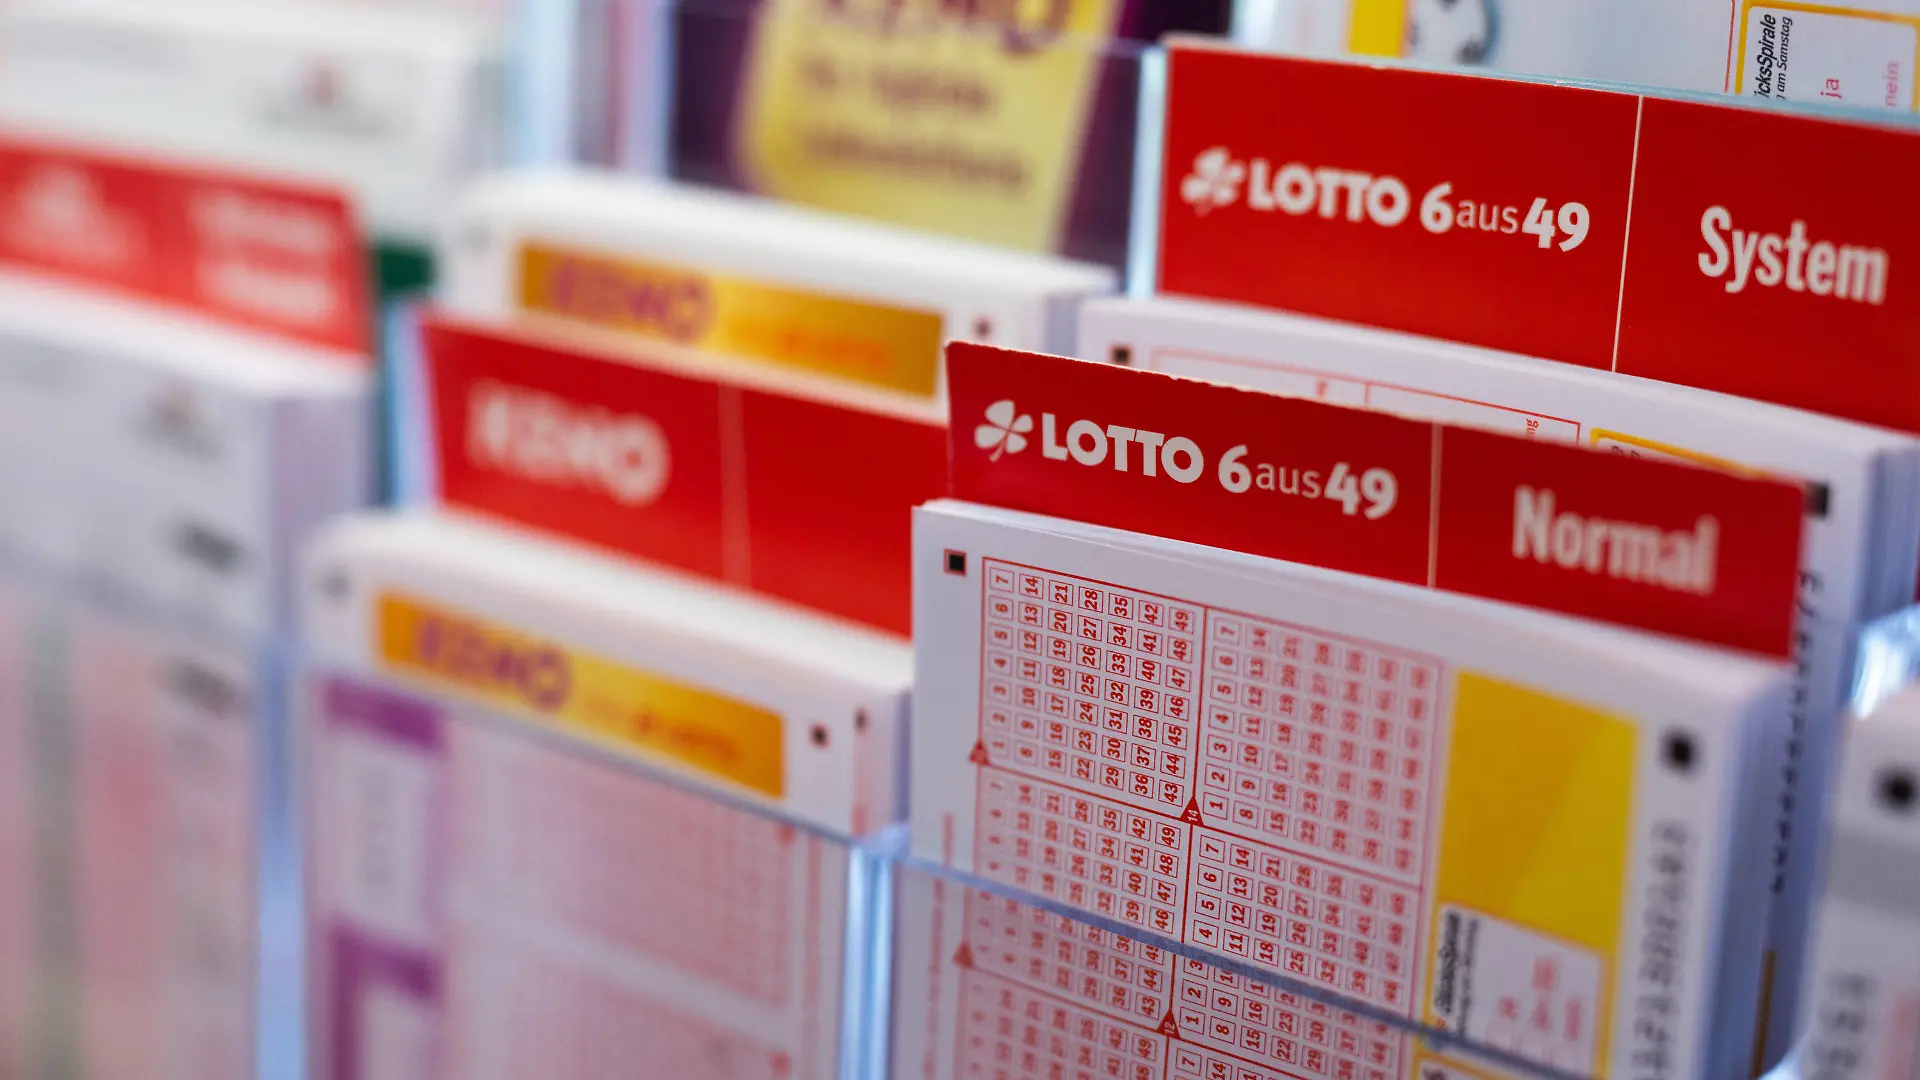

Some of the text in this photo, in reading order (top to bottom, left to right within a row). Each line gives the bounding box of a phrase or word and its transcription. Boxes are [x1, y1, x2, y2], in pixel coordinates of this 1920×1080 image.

[1776, 16, 1793, 93] am Samstag
[1820, 78, 1842, 99] ja
[1882, 60, 1899, 107] nein
[1248, 158, 1410, 226] LOTTO
[1698, 205, 1888, 305] System
[1042, 413, 1204, 483] LOTTO
[1514, 485, 1719, 595] Normal
[1025, 577, 1039, 596] 14
[1024, 605, 1038, 625] 13
[1023, 633, 1037, 653] 12
[1022, 661, 1036, 680] 11
[1047, 583, 1068, 769] 15 16 17 18 19 20 21
[1076, 590, 1097, 777] 22 23 24 25 26 27 28
[1105, 597, 1128, 785] 29 30 31 32 33 34 35
[1217, 685, 1231, 695] 5
[1021, 688, 1035, 708] 10
[1135, 604, 1158, 794] 36 37 38 39 40 41 42
[1164, 611, 1189, 802] 43 44 45 46 47 48 49
[1215, 714, 1229, 725] 4
[1247, 718, 1261, 737] 11
[1213, 743, 1227, 754] 3
[1245, 747, 1259, 766] 10
[1211, 772, 1225, 782] 2
[1243, 780, 1257, 791] 9
[1188, 808, 1199, 822] 14
[1210, 800, 1224, 811] 1
[1241, 809, 1255, 820] 8
[1102, 808, 1116, 828] 35
[1126, 817, 1145, 922] 39 40 41 42
[1155, 826, 1176, 931] 46 47 48 49
[1199, 843, 1220, 939] 4 5 6 7
[1230, 848, 1250, 952] 11 12 13 14
[1260, 857, 1281, 962] 18 19 20 21
[1291, 952, 1305, 971] 25
[1141, 969, 1157, 1015] 43 44
[1188, 987, 1202, 998] 2
[1185, 1014, 1199, 1025] 1
[1215, 997, 1232, 1035] 8 9
[1246, 1003, 1262, 1049] 15 16
[1276, 1012, 1293, 1059] 22 23
[1182, 1056, 1196, 1067] 7
